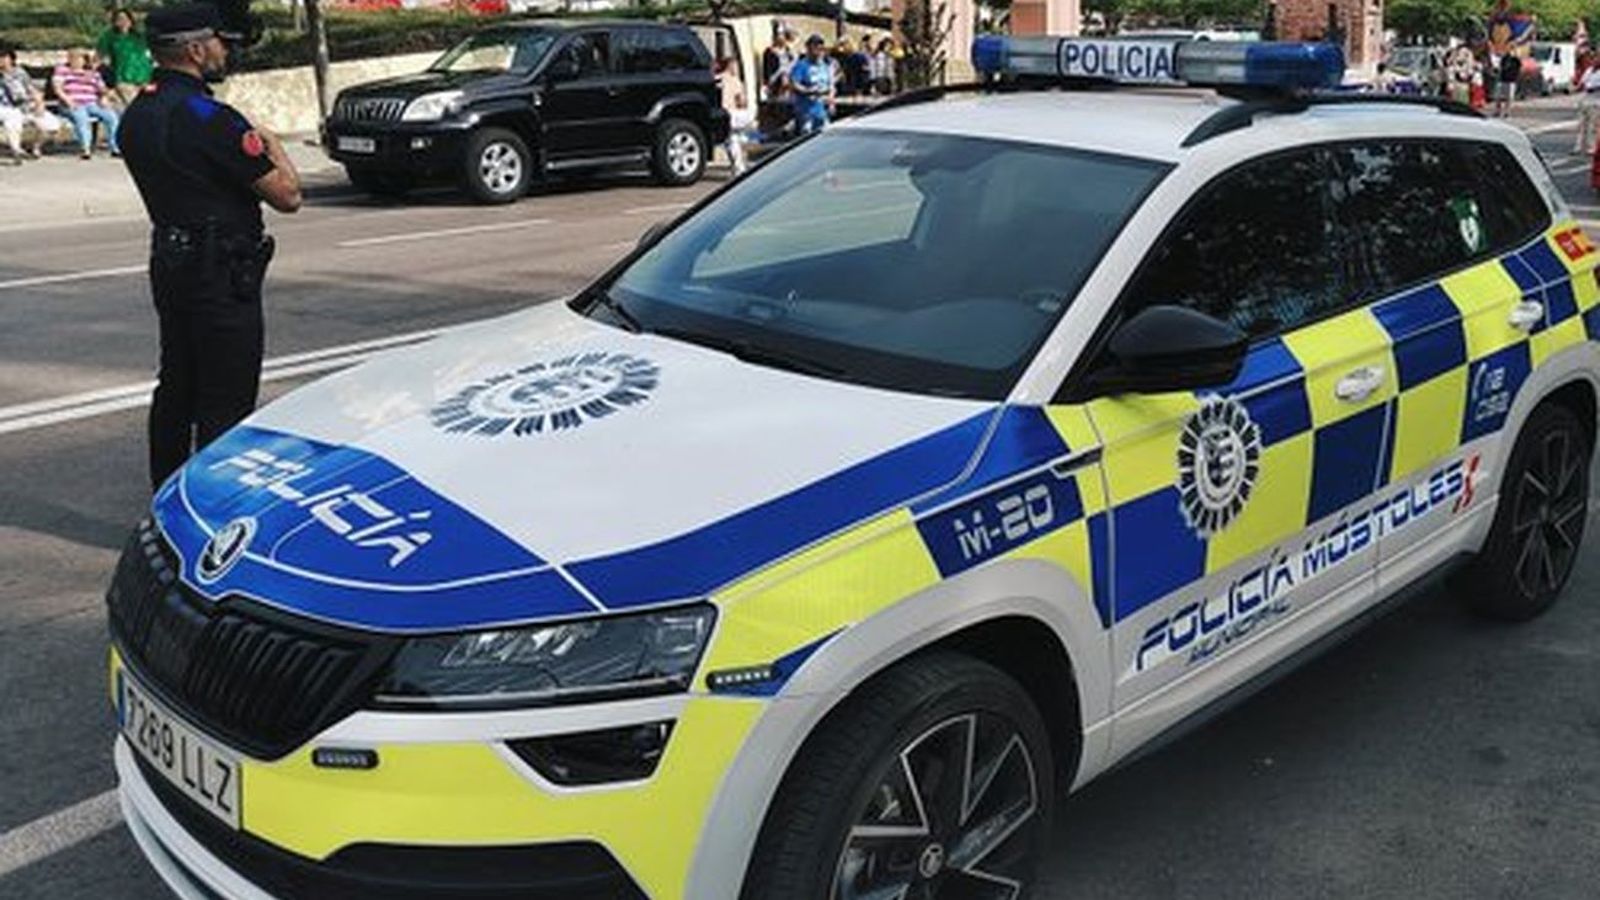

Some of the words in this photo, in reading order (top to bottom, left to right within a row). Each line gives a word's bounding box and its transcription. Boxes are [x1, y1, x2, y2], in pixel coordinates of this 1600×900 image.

[1064, 43, 1174, 78] POLICIA
[208, 449, 432, 568] POLICÍA
[953, 483, 1055, 560] M-20
[1136, 547, 1294, 672] POLICÍA
[1302, 459, 1464, 579] MÓSTOLES
[181, 735, 232, 813] LLZ
